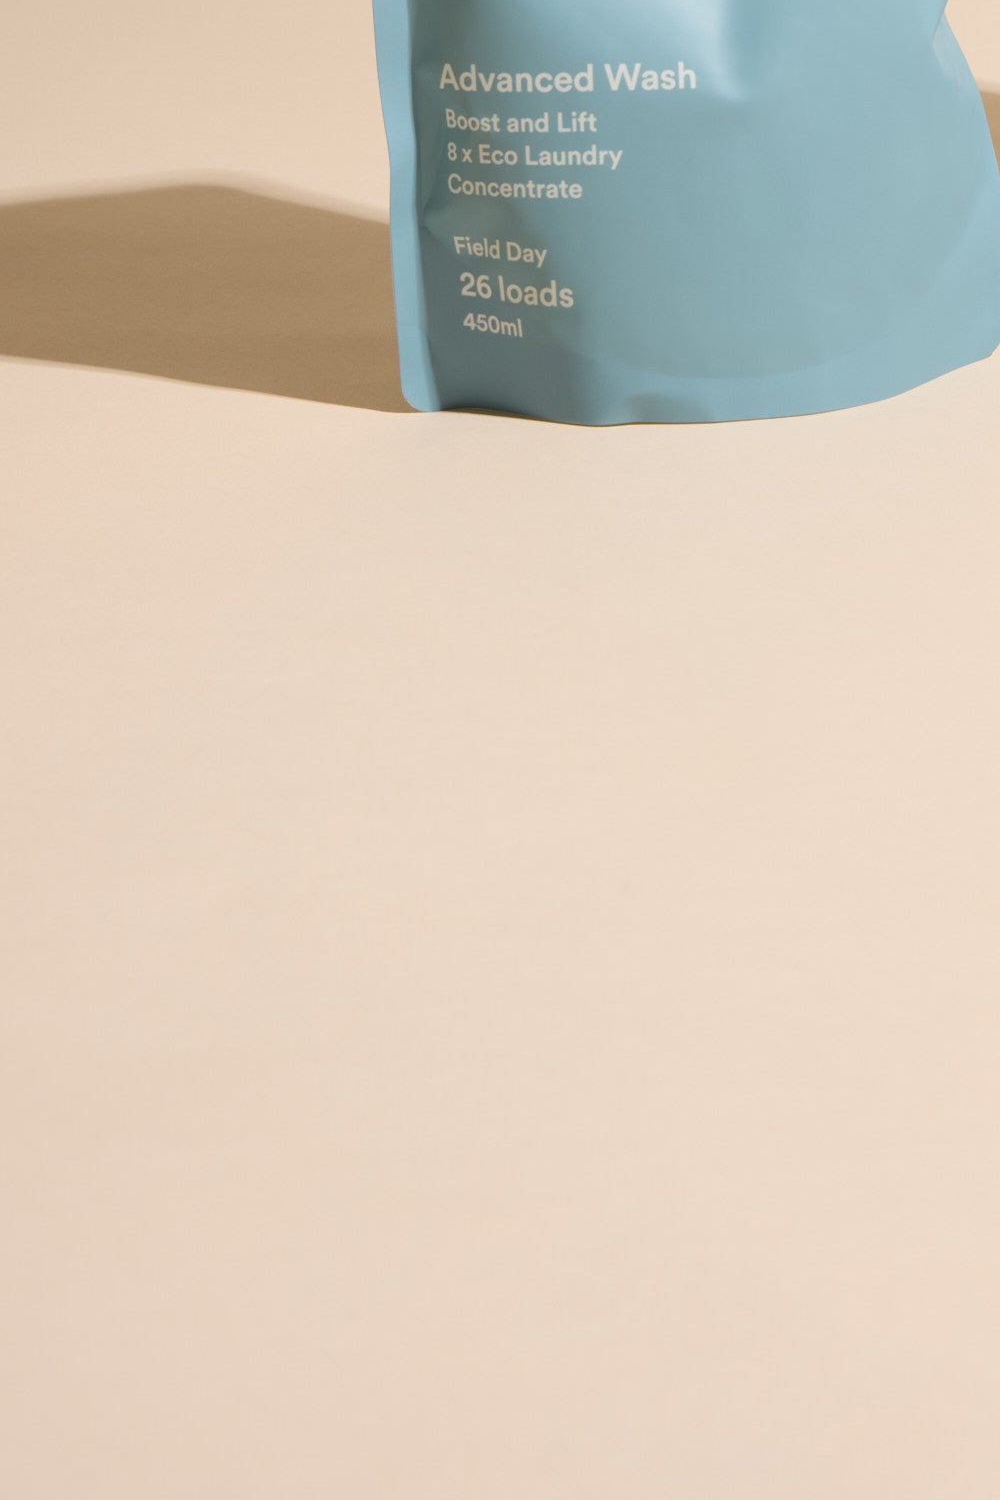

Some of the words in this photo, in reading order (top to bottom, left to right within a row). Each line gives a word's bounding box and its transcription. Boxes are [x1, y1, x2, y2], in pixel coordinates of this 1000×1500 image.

[439, 62, 594, 93] Advanced
[604, 61, 697, 91] Wash
[445, 108, 500, 132] Boost
[506, 112, 549, 133] and
[557, 111, 598, 133] Lift
[447, 142, 457, 161] 8
[462, 148, 473, 163] x
[478, 143, 518, 165] Eco
[525, 144, 623, 170] Laundry
[447, 173, 583, 199] Concentrate
[453, 236, 500, 260] Field
[506, 241, 547, 268] Day
[460, 272, 492, 299] 26
[498, 275, 574, 308] loads
[463, 313, 523, 338] 450ml
